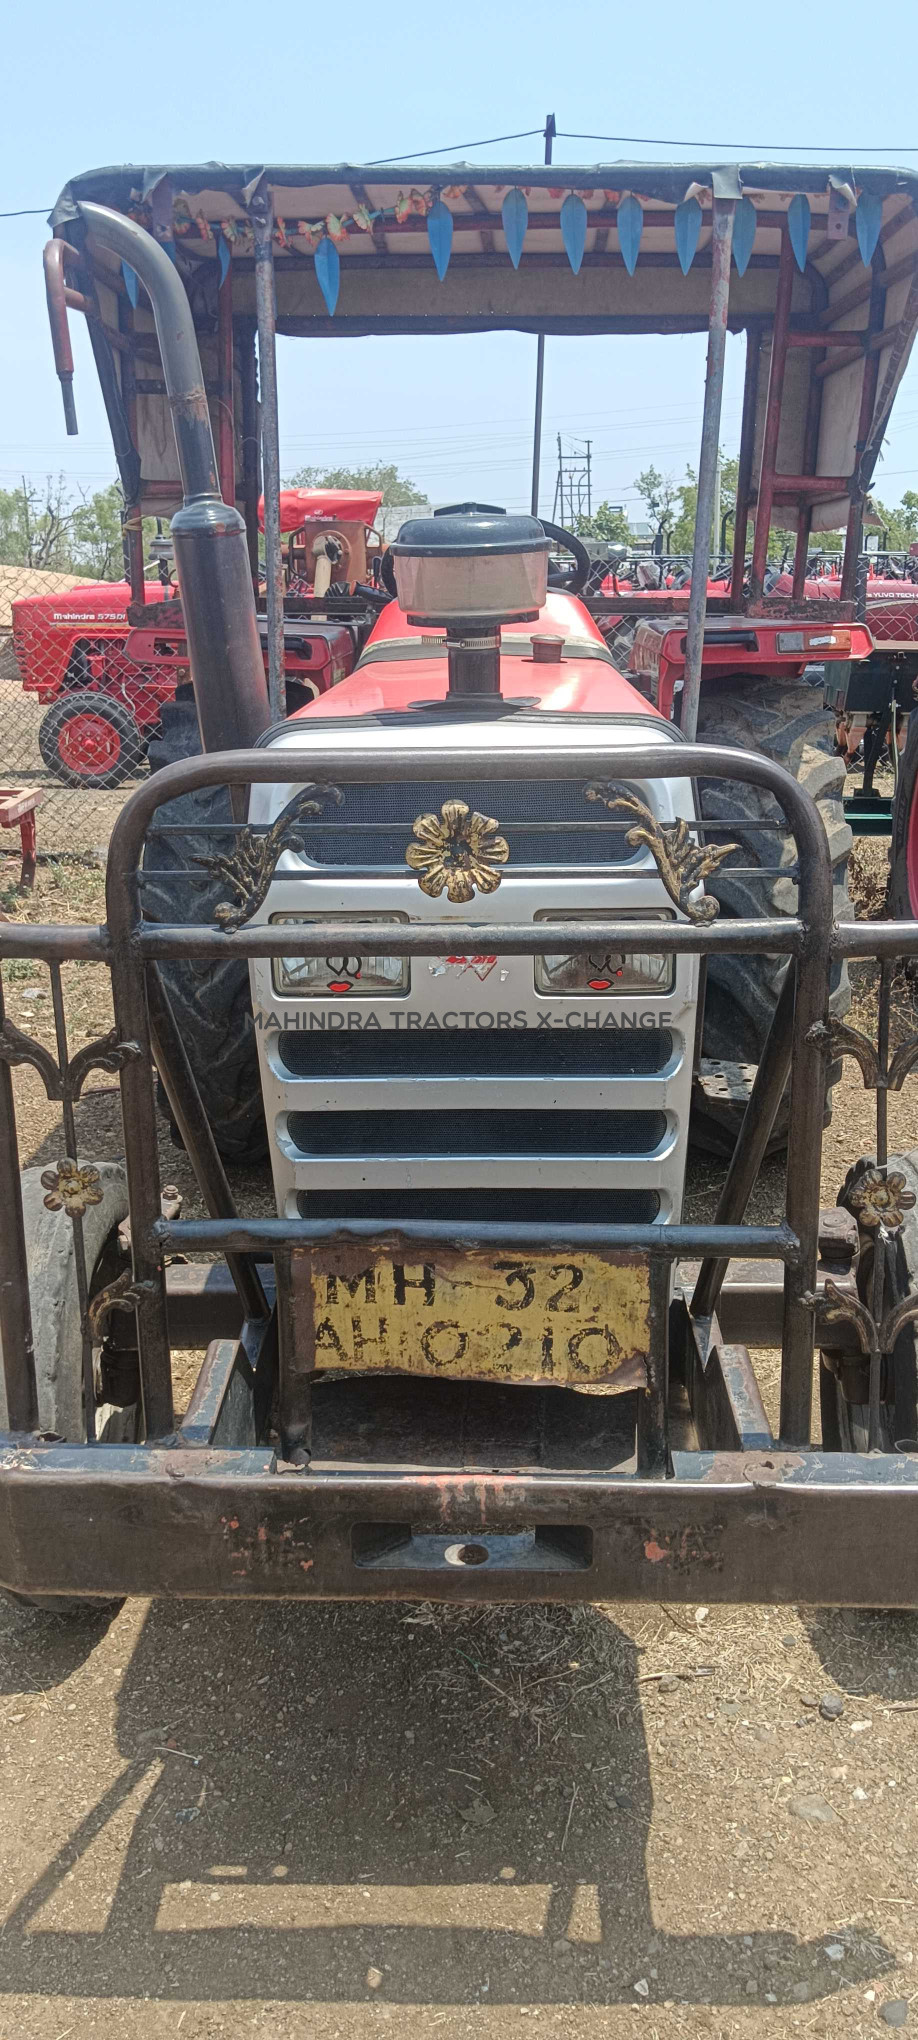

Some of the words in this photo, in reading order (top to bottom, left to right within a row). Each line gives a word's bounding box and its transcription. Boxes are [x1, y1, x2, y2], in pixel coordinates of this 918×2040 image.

[325, 1262, 436, 1307] MH
[493, 1260, 584, 1313] 32
[314, 1316, 388, 1362] AH
[420, 1319, 622, 1376] 0210
